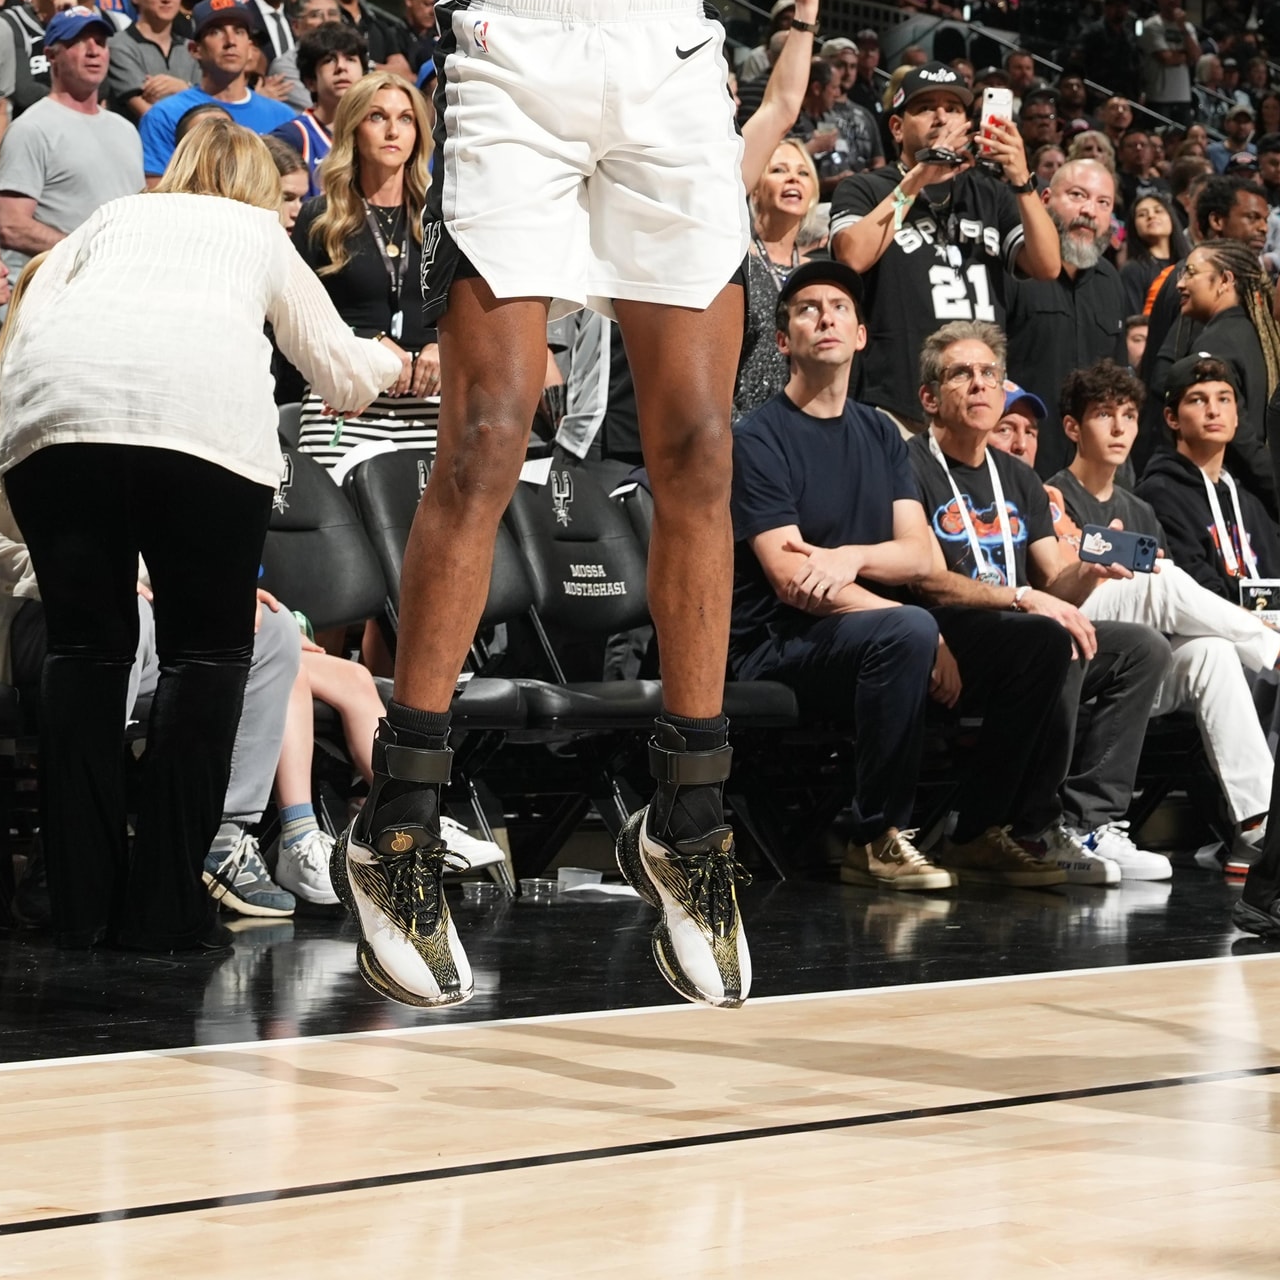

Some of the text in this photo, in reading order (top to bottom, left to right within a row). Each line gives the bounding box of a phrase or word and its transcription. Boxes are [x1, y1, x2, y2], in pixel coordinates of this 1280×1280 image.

[893, 217, 1001, 257] SPRS
[928, 264, 996, 323] 21
[570, 564, 607, 578] MOSSA
